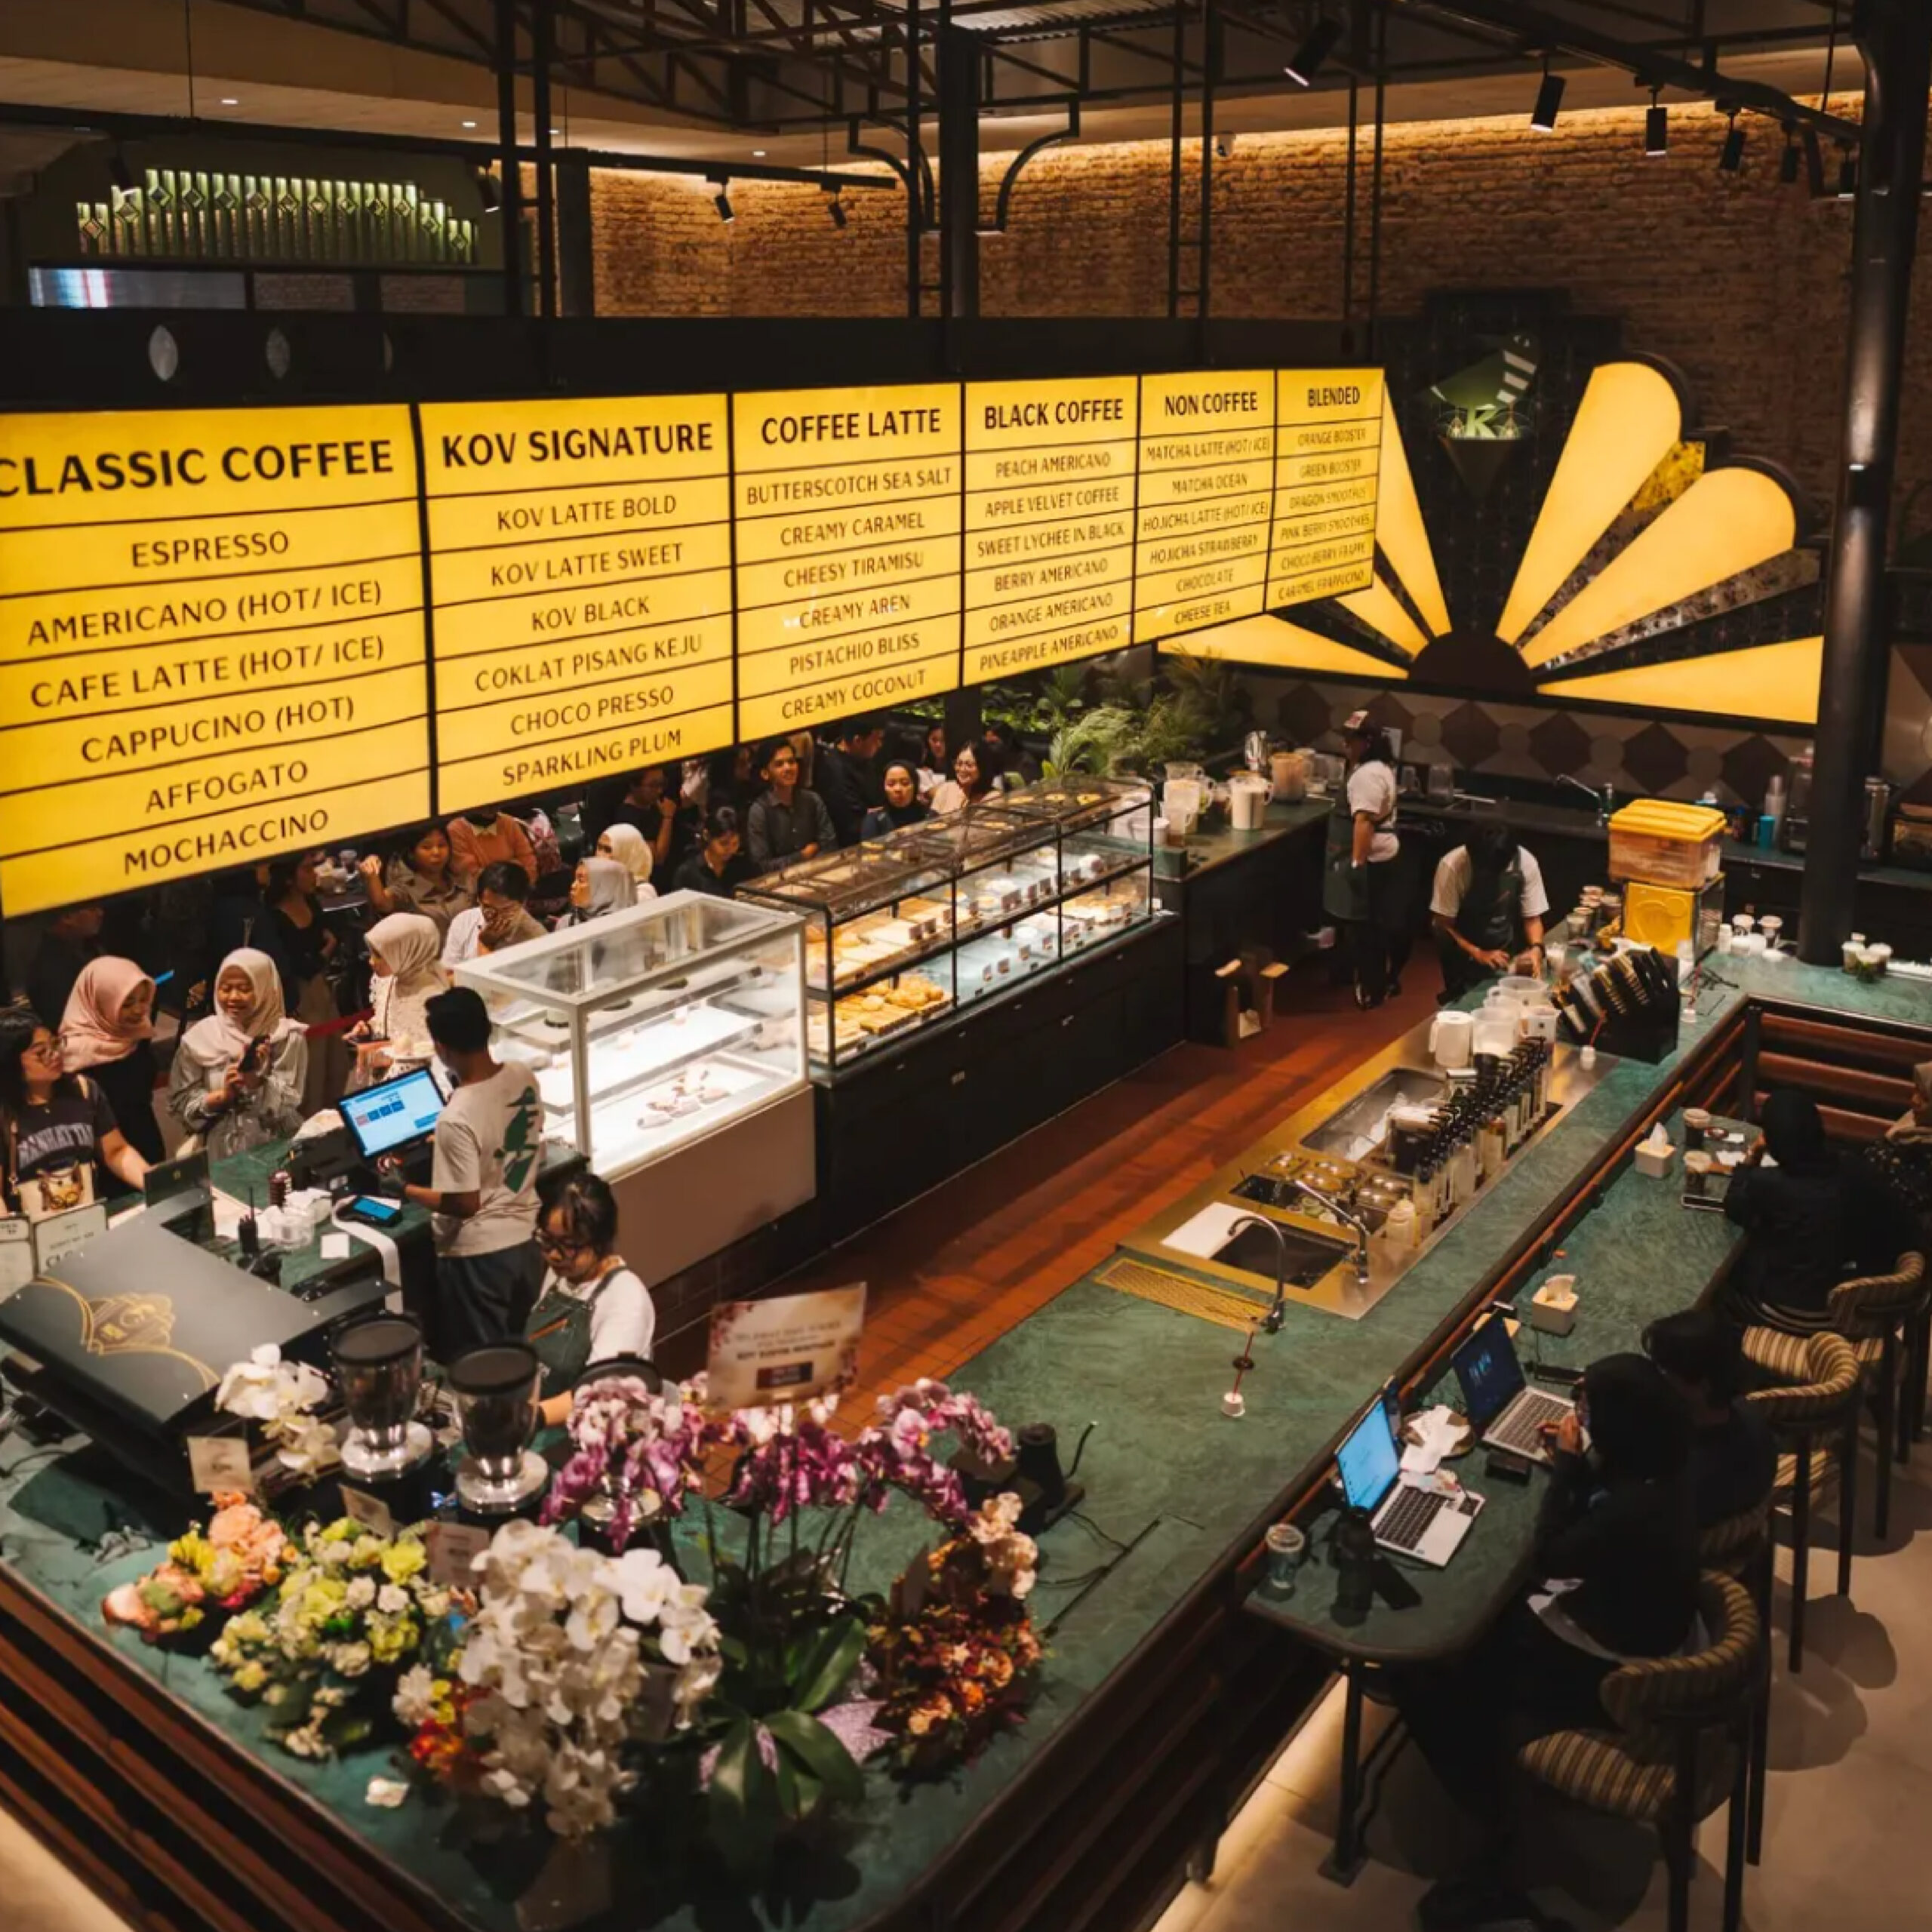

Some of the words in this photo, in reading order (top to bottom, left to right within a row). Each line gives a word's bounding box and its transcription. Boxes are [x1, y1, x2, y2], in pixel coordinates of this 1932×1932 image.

[984, 403, 1049, 429] BLACK
[1055, 398, 1124, 425] COFFEE
[1164, 395, 1198, 416] NON
[1201, 391, 1258, 414] COFFEE
[1308, 386, 1361, 408] BLENDED
[761, 412, 860, 445] COFFEE
[868, 408, 940, 437] LATTE
[442, 432, 516, 468] KOV
[528, 423, 712, 462] SIGNATURE
[1146, 444, 1192, 460] MATCHA
[1193, 441, 1225, 458] LATTE
[0, 448, 207, 498] CLASSIC
[221, 439, 393, 482] COFFEE
[995, 459, 1038, 478] PEACH
[1041, 451, 1111, 472] AMERICANO
[1172, 476, 1214, 494] MATCHA
[1216, 472, 1247, 490] OCEAN
[746, 474, 878, 506] BUTTERSCOTCH
[882, 471, 912, 491] SEA
[916, 466, 951, 488] SALT
[985, 497, 1025, 518] APPLE
[1027, 491, 1073, 512] VELVET
[1075, 486, 1119, 506] COFFEE
[497, 508, 543, 531] KOV
[552, 500, 615, 526] LATTE
[623, 495, 677, 518] BOLD
[780, 521, 848, 546] CREAMY
[852, 512, 925, 536] CARAMEL
[1192, 507, 1221, 525] LATTE
[131, 531, 289, 568] ESPRESSO
[977, 536, 1021, 558] SWEET
[1023, 528, 1071, 552] LYCHEE
[1073, 527, 1086, 542] IN
[1088, 521, 1125, 541] BLACK
[491, 562, 539, 586] KOV
[546, 552, 610, 580] LATTE
[617, 543, 682, 570] SWEET
[783, 562, 846, 589] CHEESY
[852, 552, 922, 577] TIRAMISU
[994, 571, 1034, 592] BERRY
[1040, 558, 1108, 584] AMERICANO
[1175, 568, 1233, 592] CHOCOLATE
[27, 598, 227, 647] AMERICANO
[237, 587, 321, 622] (HOT/
[331, 580, 381, 607] ICE)
[532, 607, 577, 631] KOV
[584, 596, 651, 623] BLACK
[799, 601, 864, 629] CREAMY
[869, 594, 910, 615] AREN
[990, 606, 1042, 632] ORANGE
[1046, 592, 1113, 619] AMERICANO
[1174, 605, 1211, 626] CHEESE
[1213, 600, 1231, 615] TEA
[474, 657, 565, 692] COKLAT
[572, 643, 648, 675] PISANG
[654, 635, 702, 660] KEJU
[790, 641, 872, 674] PISTACHIO
[877, 632, 919, 655] BLISS
[980, 641, 1048, 671] PINEAPPLE
[1051, 626, 1118, 654] AMERICANO
[30, 672, 120, 709] CAFE
[132, 657, 228, 694] LATTE
[239, 645, 323, 681] (HOT/
[334, 635, 384, 663] ICE)
[510, 702, 591, 736] CHOCO
[598, 685, 674, 718] PRESSO
[781, 688, 846, 719] CREAMY
[853, 669, 925, 701] COCONUT
[82, 710, 265, 763] CAPPUCINO
[275, 697, 354, 733] (HOT)
[503, 742, 623, 786] SPARKLING
[629, 728, 681, 757] PLUM
[146, 761, 308, 813] AFFOGATO
[125, 810, 329, 875] MOCHACCINO
